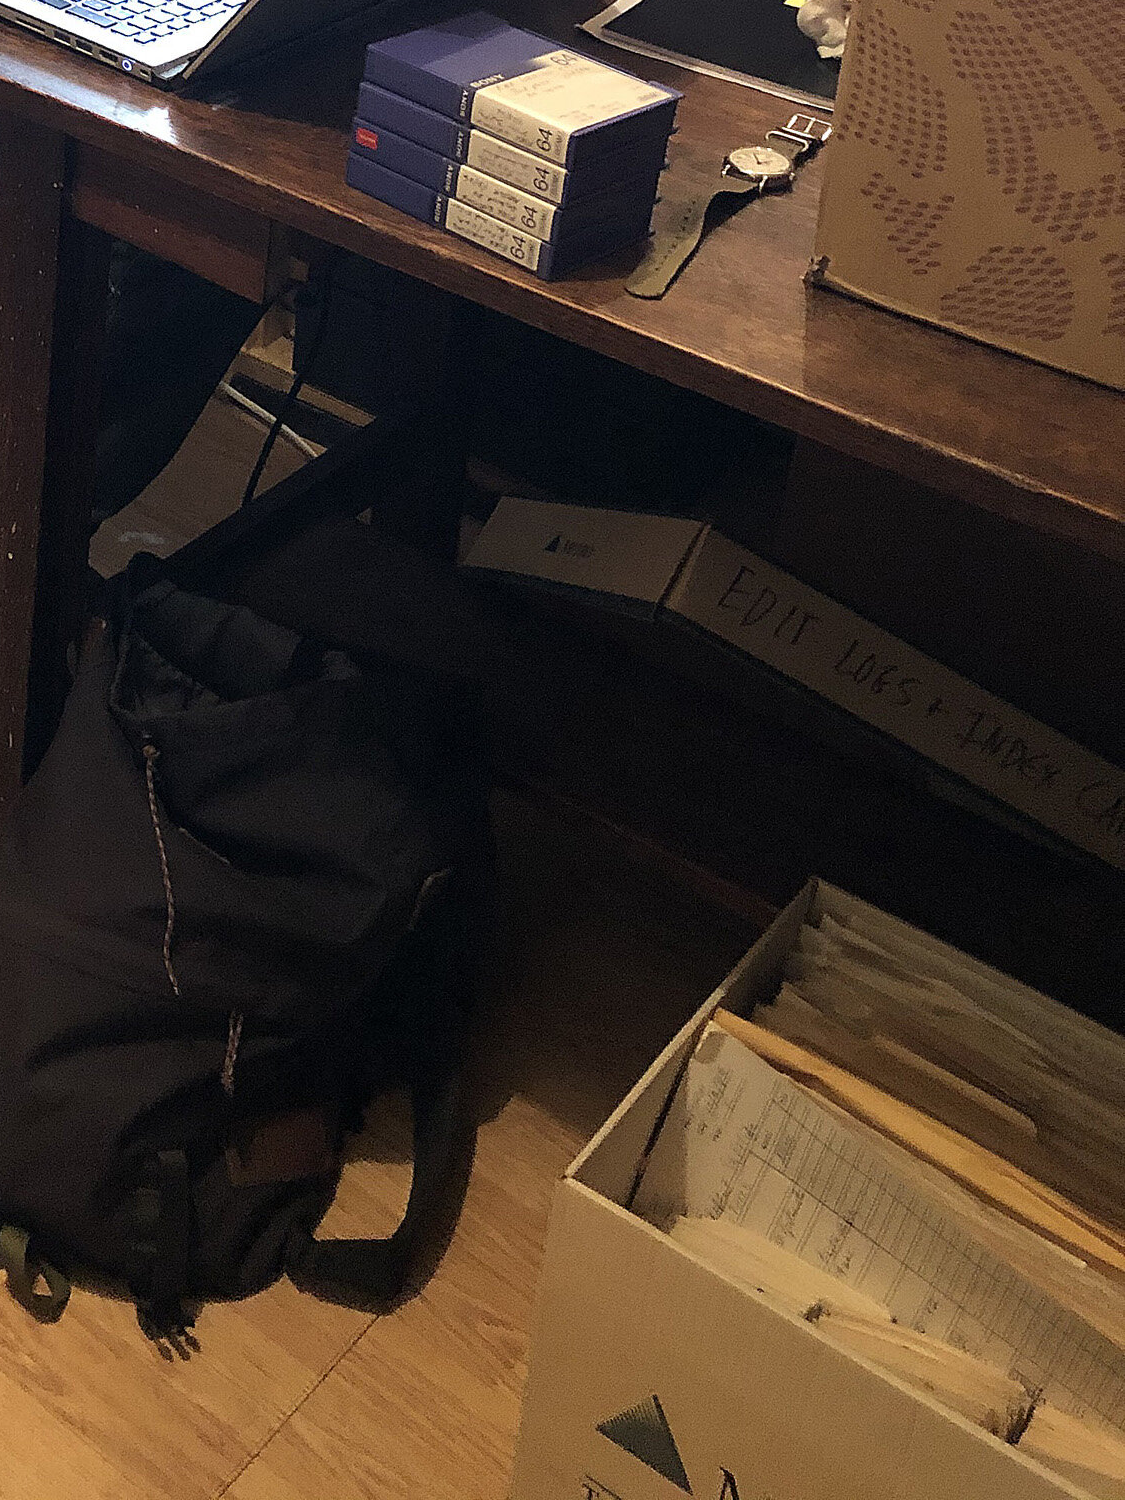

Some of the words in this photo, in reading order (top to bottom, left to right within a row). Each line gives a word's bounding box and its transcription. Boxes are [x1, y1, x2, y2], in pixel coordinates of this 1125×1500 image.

[470, 73, 505, 88] SONY
[550, 52, 578, 66] 64
[459, 89, 469, 117] SONY
[536, 127, 553, 152] 64
[455, 130, 465, 158] SONY
[533, 167, 550, 192] 64
[434, 196, 443, 223] SONY
[509, 234, 527, 260] 64
[444, 164, 454, 192] SONY
[520, 205, 538, 229] 64
[717, 564, 822, 646] EDIT
[833, 638, 923, 707] LOGS
